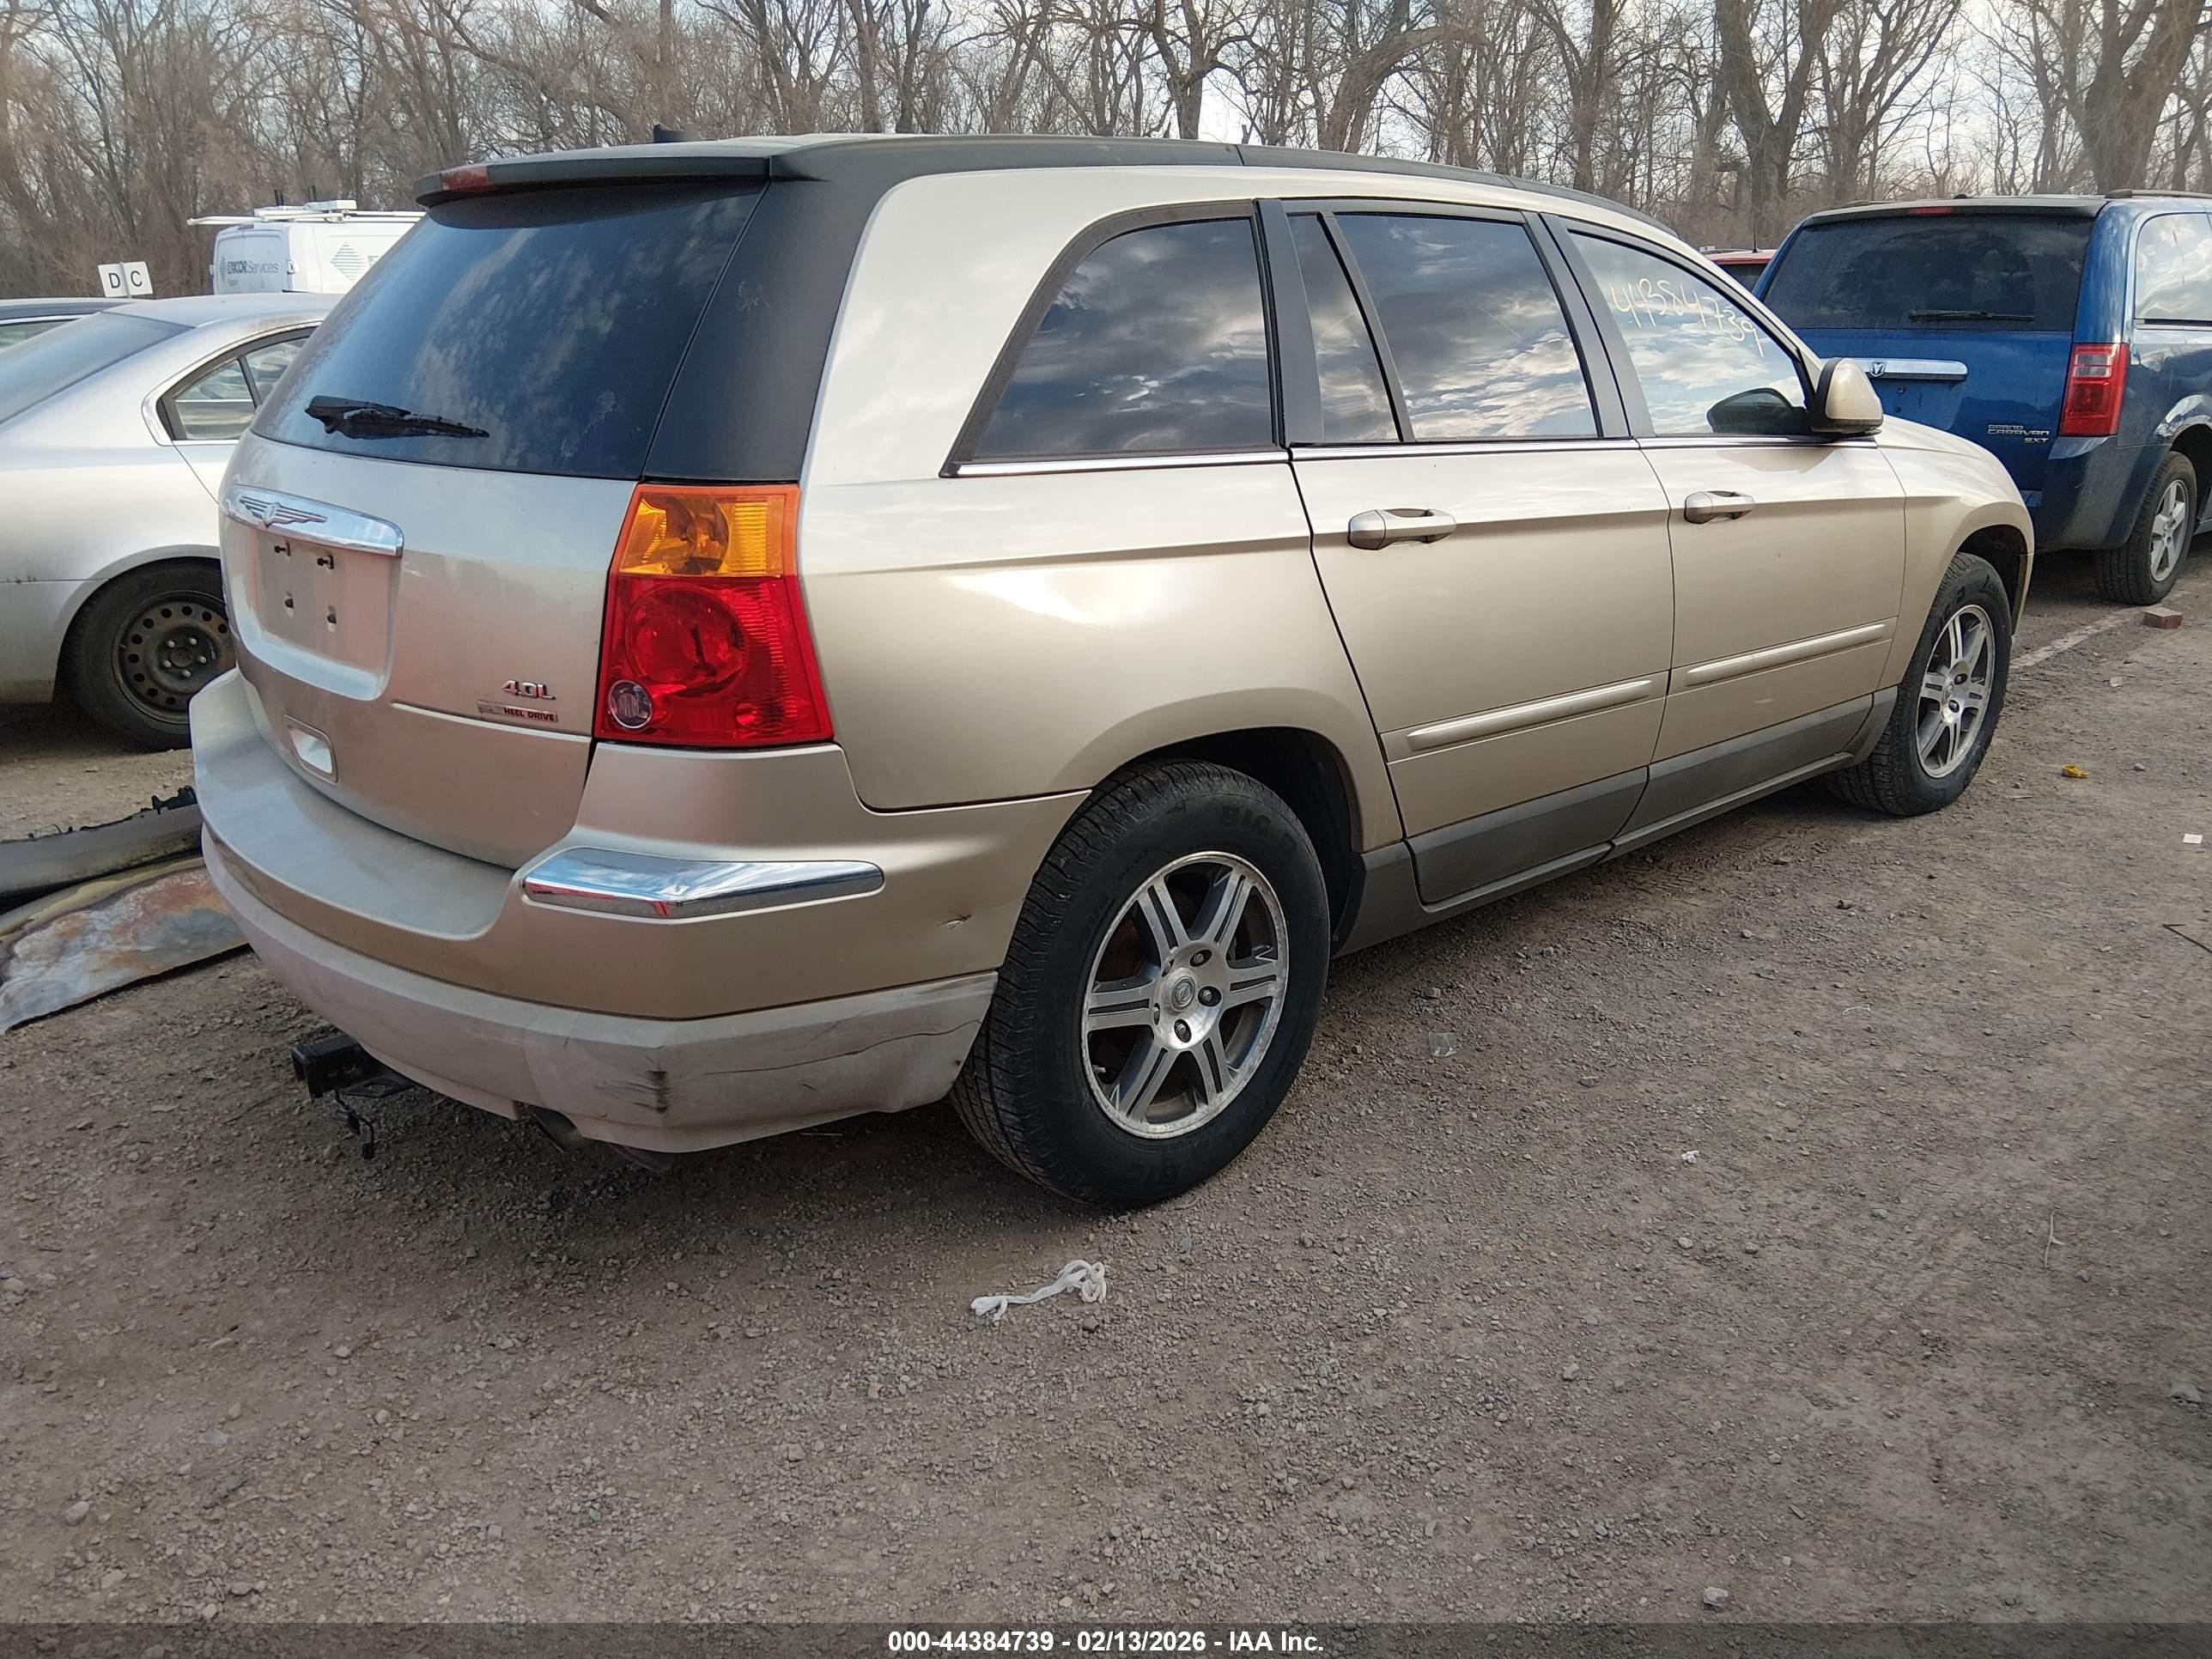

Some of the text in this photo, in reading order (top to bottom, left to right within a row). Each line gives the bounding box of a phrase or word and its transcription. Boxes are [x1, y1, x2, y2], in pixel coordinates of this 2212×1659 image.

[247, 260, 279, 275] Services
[108, 270, 143, 289] D C
[1609, 277, 1765, 358] 44384739
[527, 711, 555, 722] DRIVE
